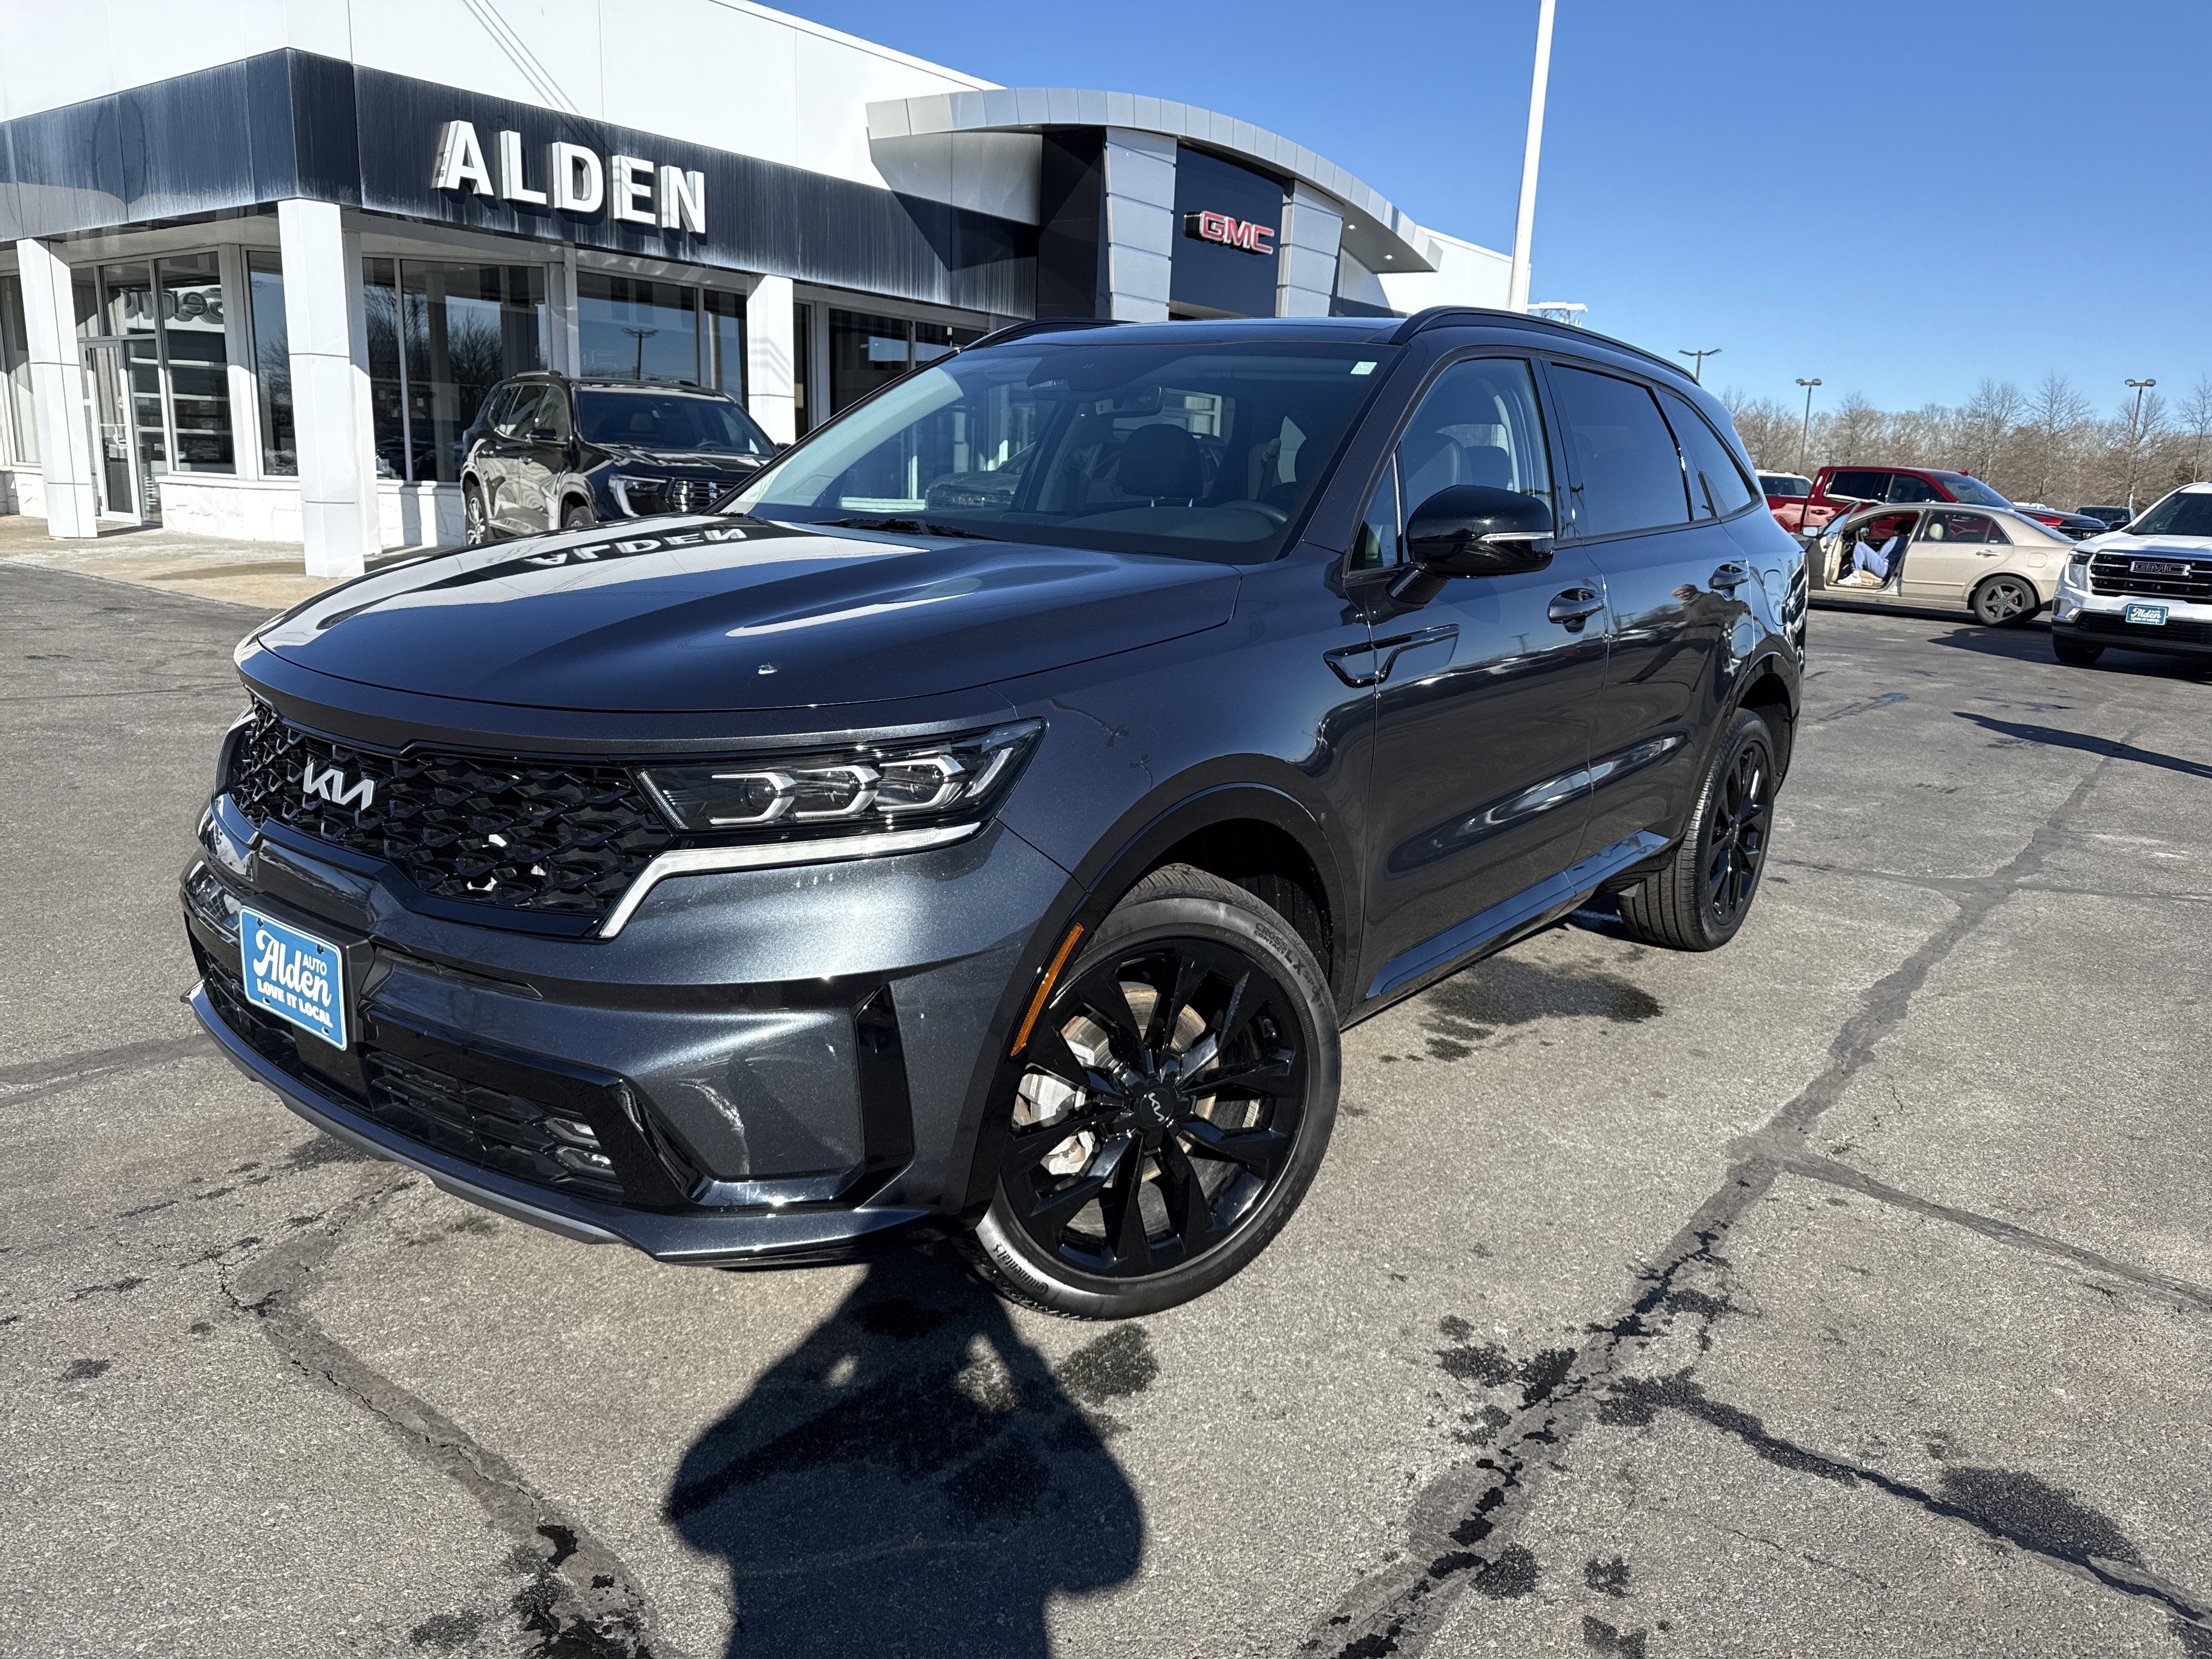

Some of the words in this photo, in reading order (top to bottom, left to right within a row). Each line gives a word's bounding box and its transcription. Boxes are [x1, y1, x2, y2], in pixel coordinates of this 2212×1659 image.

[436, 120, 706, 234] ALDEN
[1198, 210, 1276, 255] GMC
[2134, 562, 2184, 574] GMC
[2130, 607, 2162, 619] Alden
[1254, 930, 1284, 955] CONTACT
[1255, 922, 1288, 951] CROSS
[253, 929, 332, 1007] Alden
[302, 953, 327, 976] AUTO
[1284, 950, 1306, 976] LX
[1302, 970, 1324, 1008] SPORT
[256, 978, 285, 1004] LOVE
[286, 991, 298, 1009] IT
[298, 998, 333, 1029] LOCAL
[996, 1249, 1049, 1294] Continental
